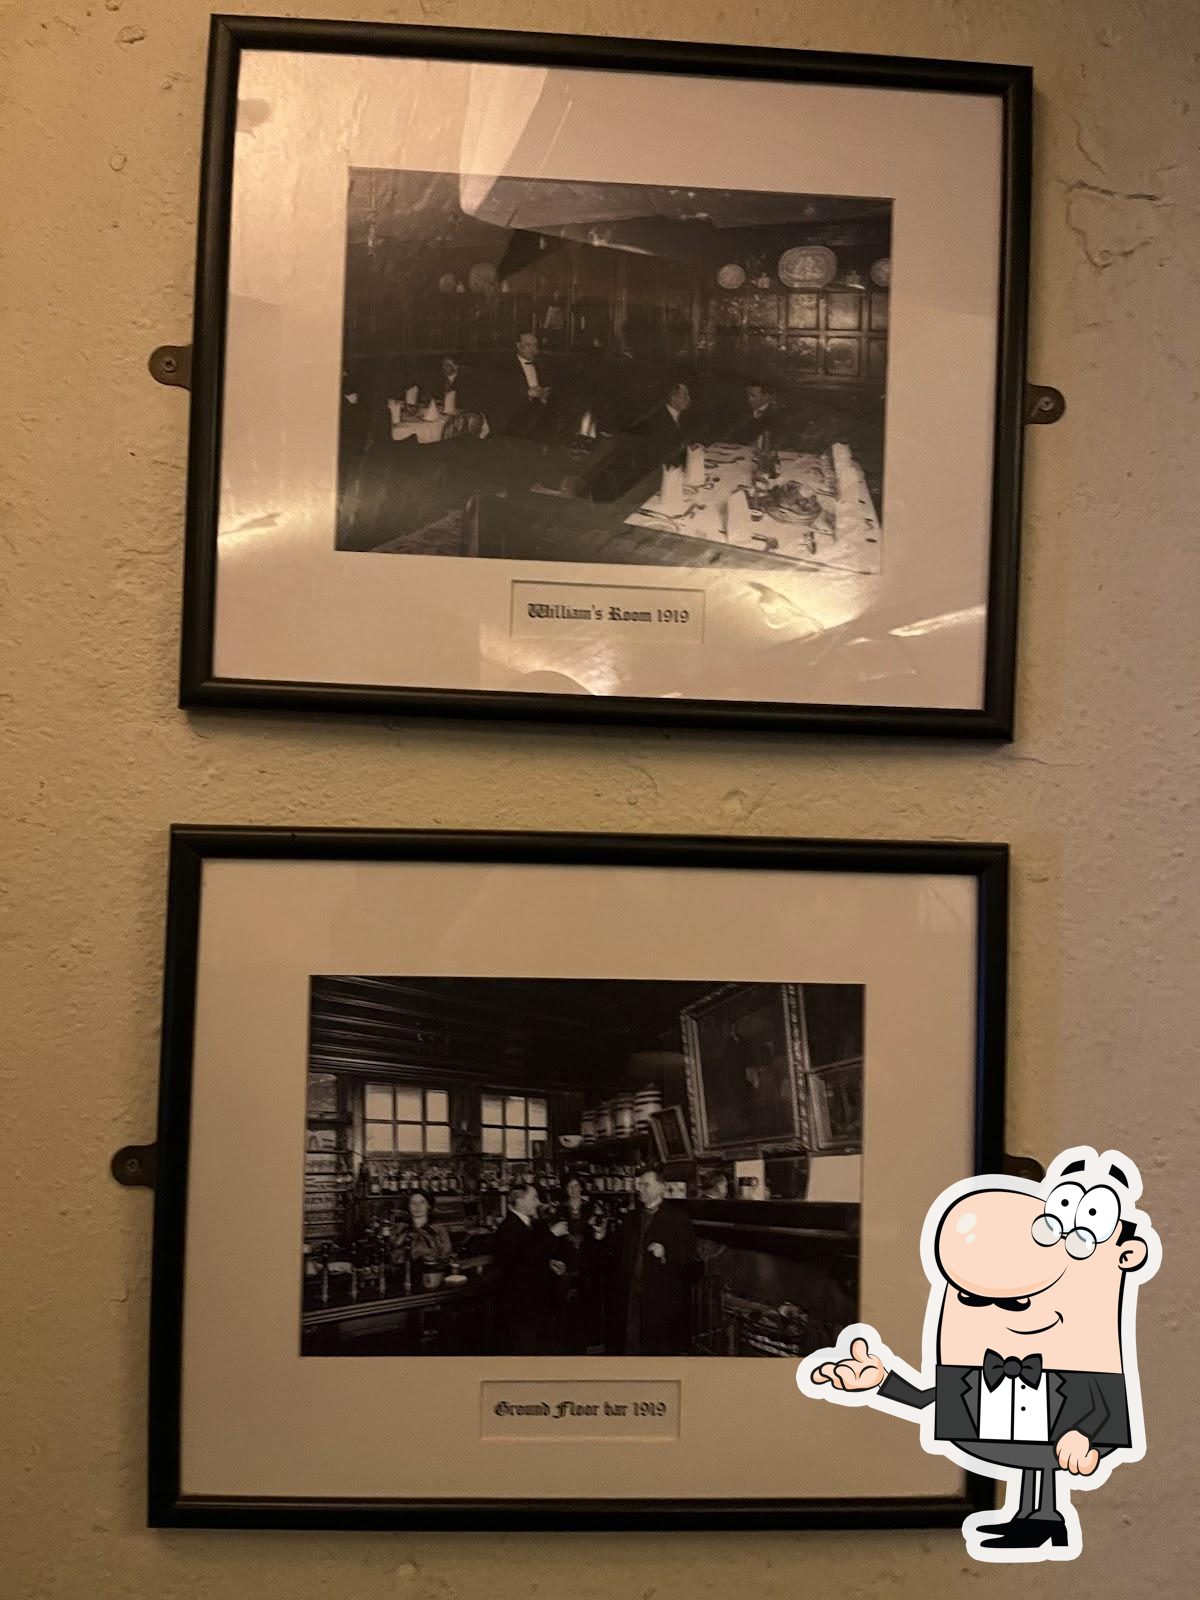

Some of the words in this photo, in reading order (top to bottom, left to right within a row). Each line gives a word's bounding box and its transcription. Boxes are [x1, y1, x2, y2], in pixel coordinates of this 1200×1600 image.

[528, 603, 602, 620] William's
[608, 606, 652, 622] Room
[657, 608, 689, 623] 1919
[494, 1400, 550, 1416] Ground
[552, 1401, 600, 1419] Floor
[603, 1401, 628, 1416] bar
[633, 1401, 667, 1416] 1919
